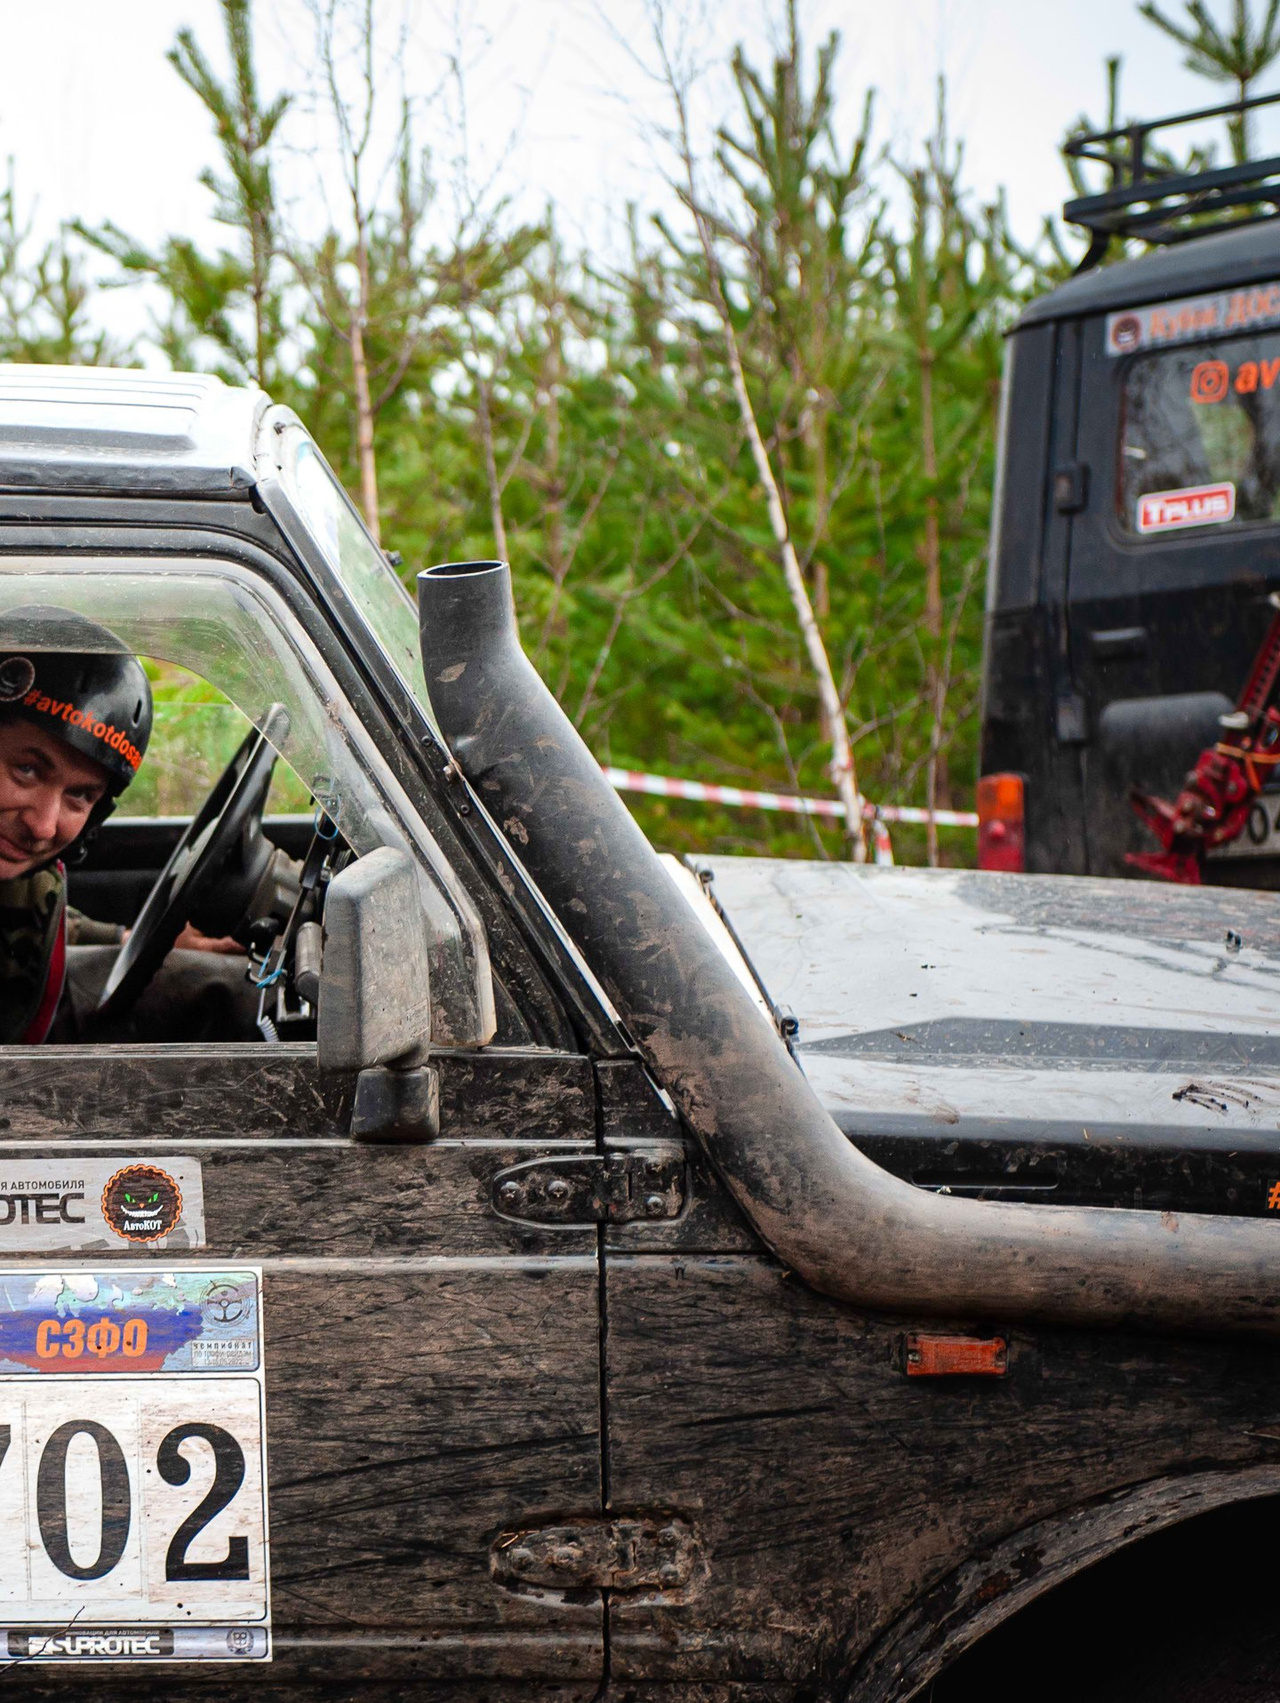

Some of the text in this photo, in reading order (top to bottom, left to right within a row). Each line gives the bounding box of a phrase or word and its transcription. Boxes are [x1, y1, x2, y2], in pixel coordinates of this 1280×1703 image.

[1145, 495, 1227, 524] TPLUS
[10, 1180, 85, 1190] АВТОМОБИЛЯ
[36, 1317, 148, 1358] СЗФО
[51, 1637, 160, 1655] SUPROTEC
